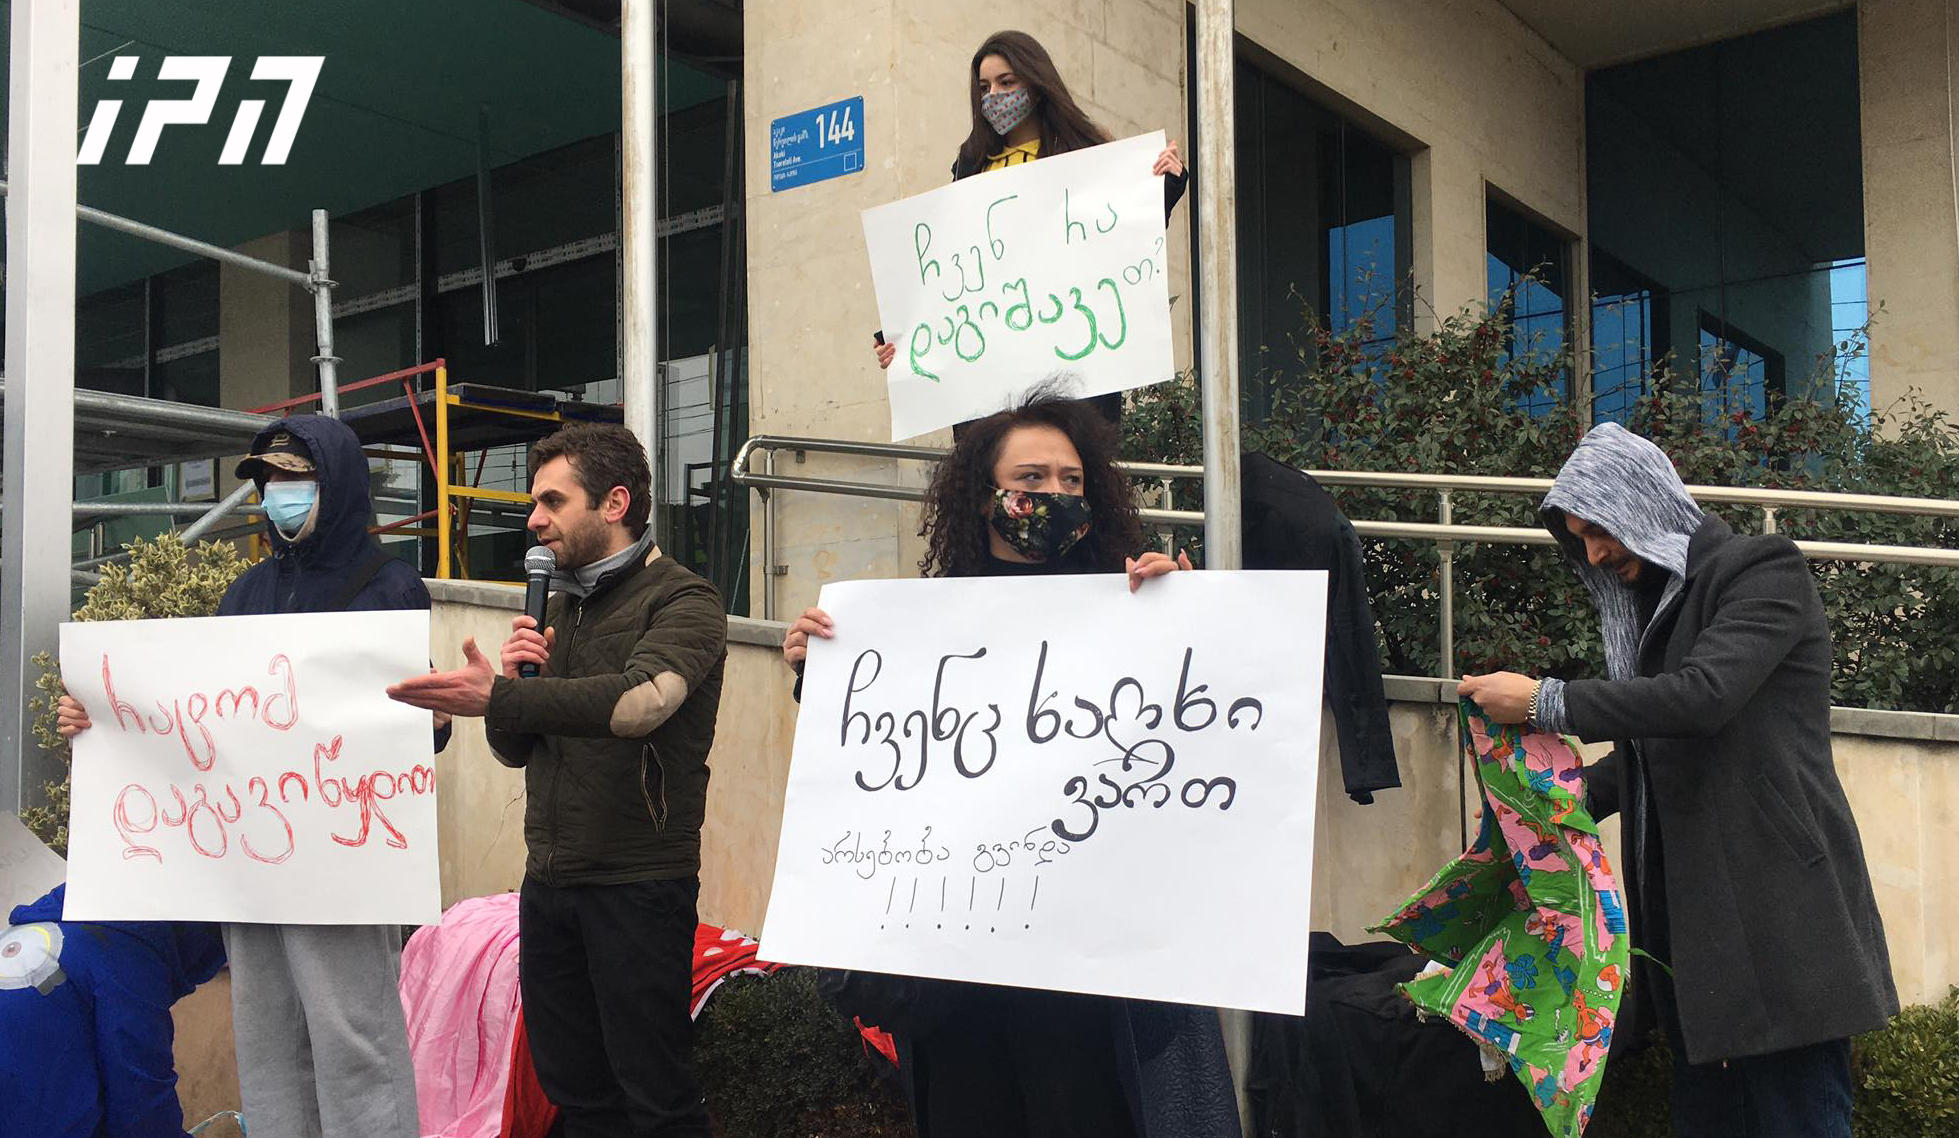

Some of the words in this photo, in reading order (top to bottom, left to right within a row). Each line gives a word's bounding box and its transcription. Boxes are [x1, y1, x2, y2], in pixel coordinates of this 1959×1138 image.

[816, 105, 855, 149] 144
[914, 195, 1018, 301] ჩვენ
[1065, 188, 1118, 245] რა
[101, 652, 299, 772] რატომ
[841, 648, 1001, 792] ჩვენც
[1026, 640, 1263, 765] ხალხი
[113, 735, 436, 864] დაგავიწყდით
[1051, 739, 1237, 842] ვართ
[821, 826, 950, 880] არსებობა
[973, 826, 1071, 873] გვინდა
